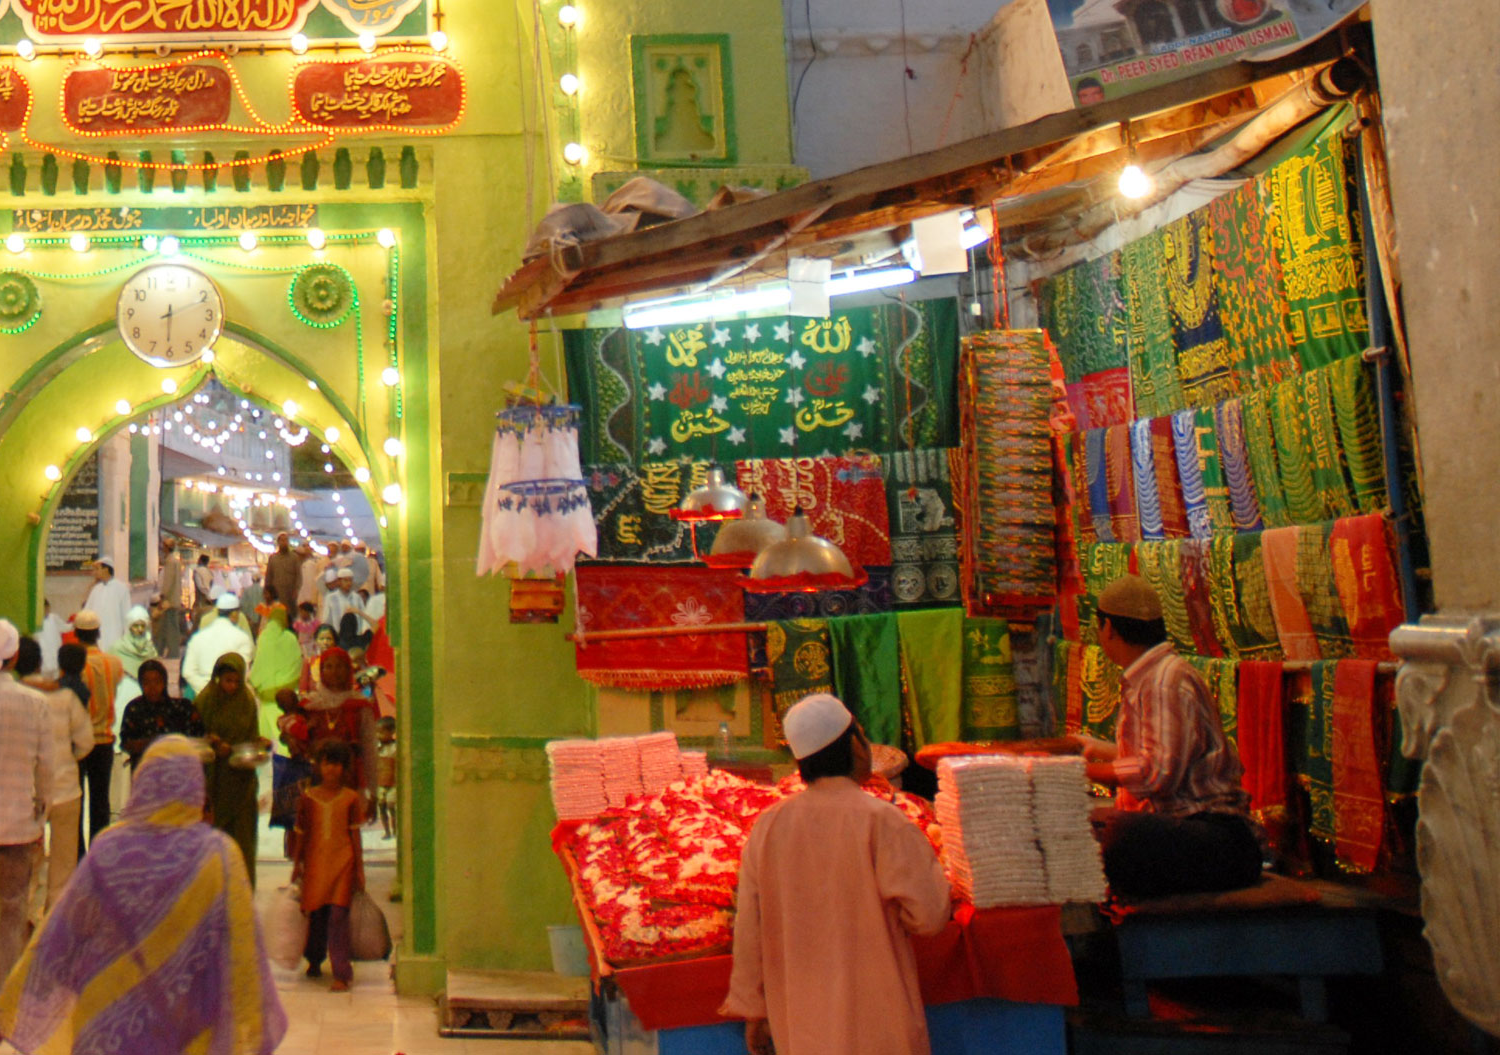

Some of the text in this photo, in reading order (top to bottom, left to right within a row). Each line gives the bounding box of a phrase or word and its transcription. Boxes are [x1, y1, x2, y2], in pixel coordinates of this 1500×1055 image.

[1100, 20, 1295, 84] Dr. PEER SYED IRFAN MOIN USMANI
[134, 290, 146, 301] 10
[200, 290, 207, 302] 2
[127, 308, 135, 320] 9
[205, 309, 213, 321] 3
[133, 327, 140, 339] 8
[199, 329, 206, 339] 4
[149, 341, 157, 352] 7
[166, 346, 173, 358] 6
[185, 341, 193, 353] 5
